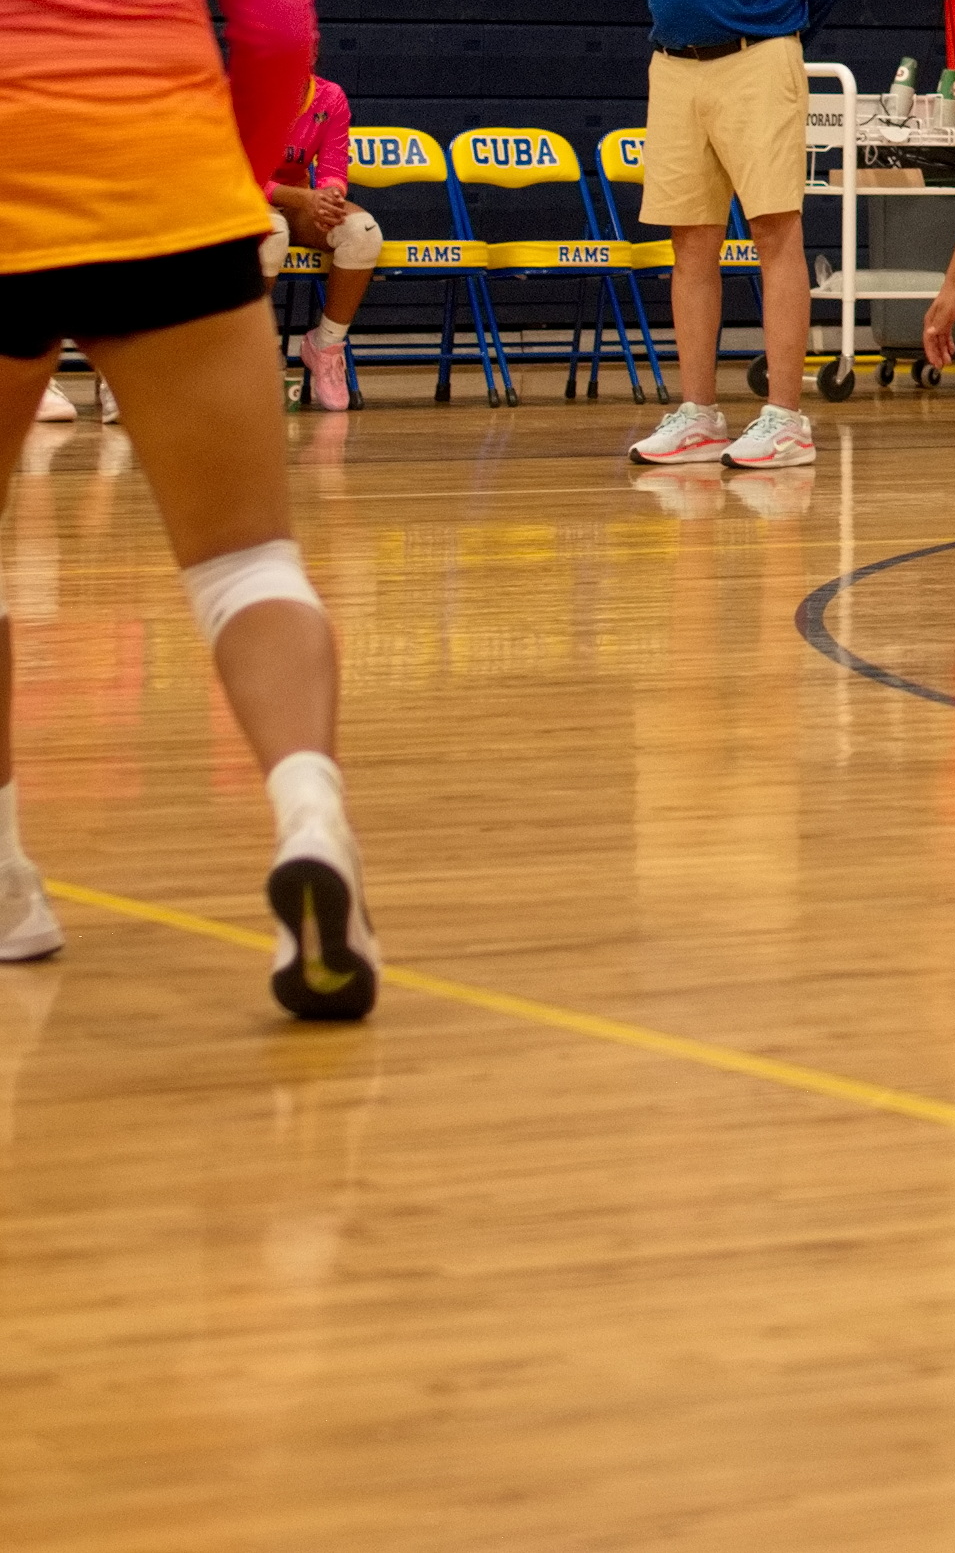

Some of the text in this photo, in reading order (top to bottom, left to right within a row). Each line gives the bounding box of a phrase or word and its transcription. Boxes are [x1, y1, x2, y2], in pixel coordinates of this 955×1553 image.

[348, 136, 429, 167] UBA
[471, 135, 560, 168] CUBA
[620, 137, 646, 167] C
[407, 246, 462, 263] RAMS
[558, 246, 610, 263] RAMS
[719, 244, 759, 262] AMS
